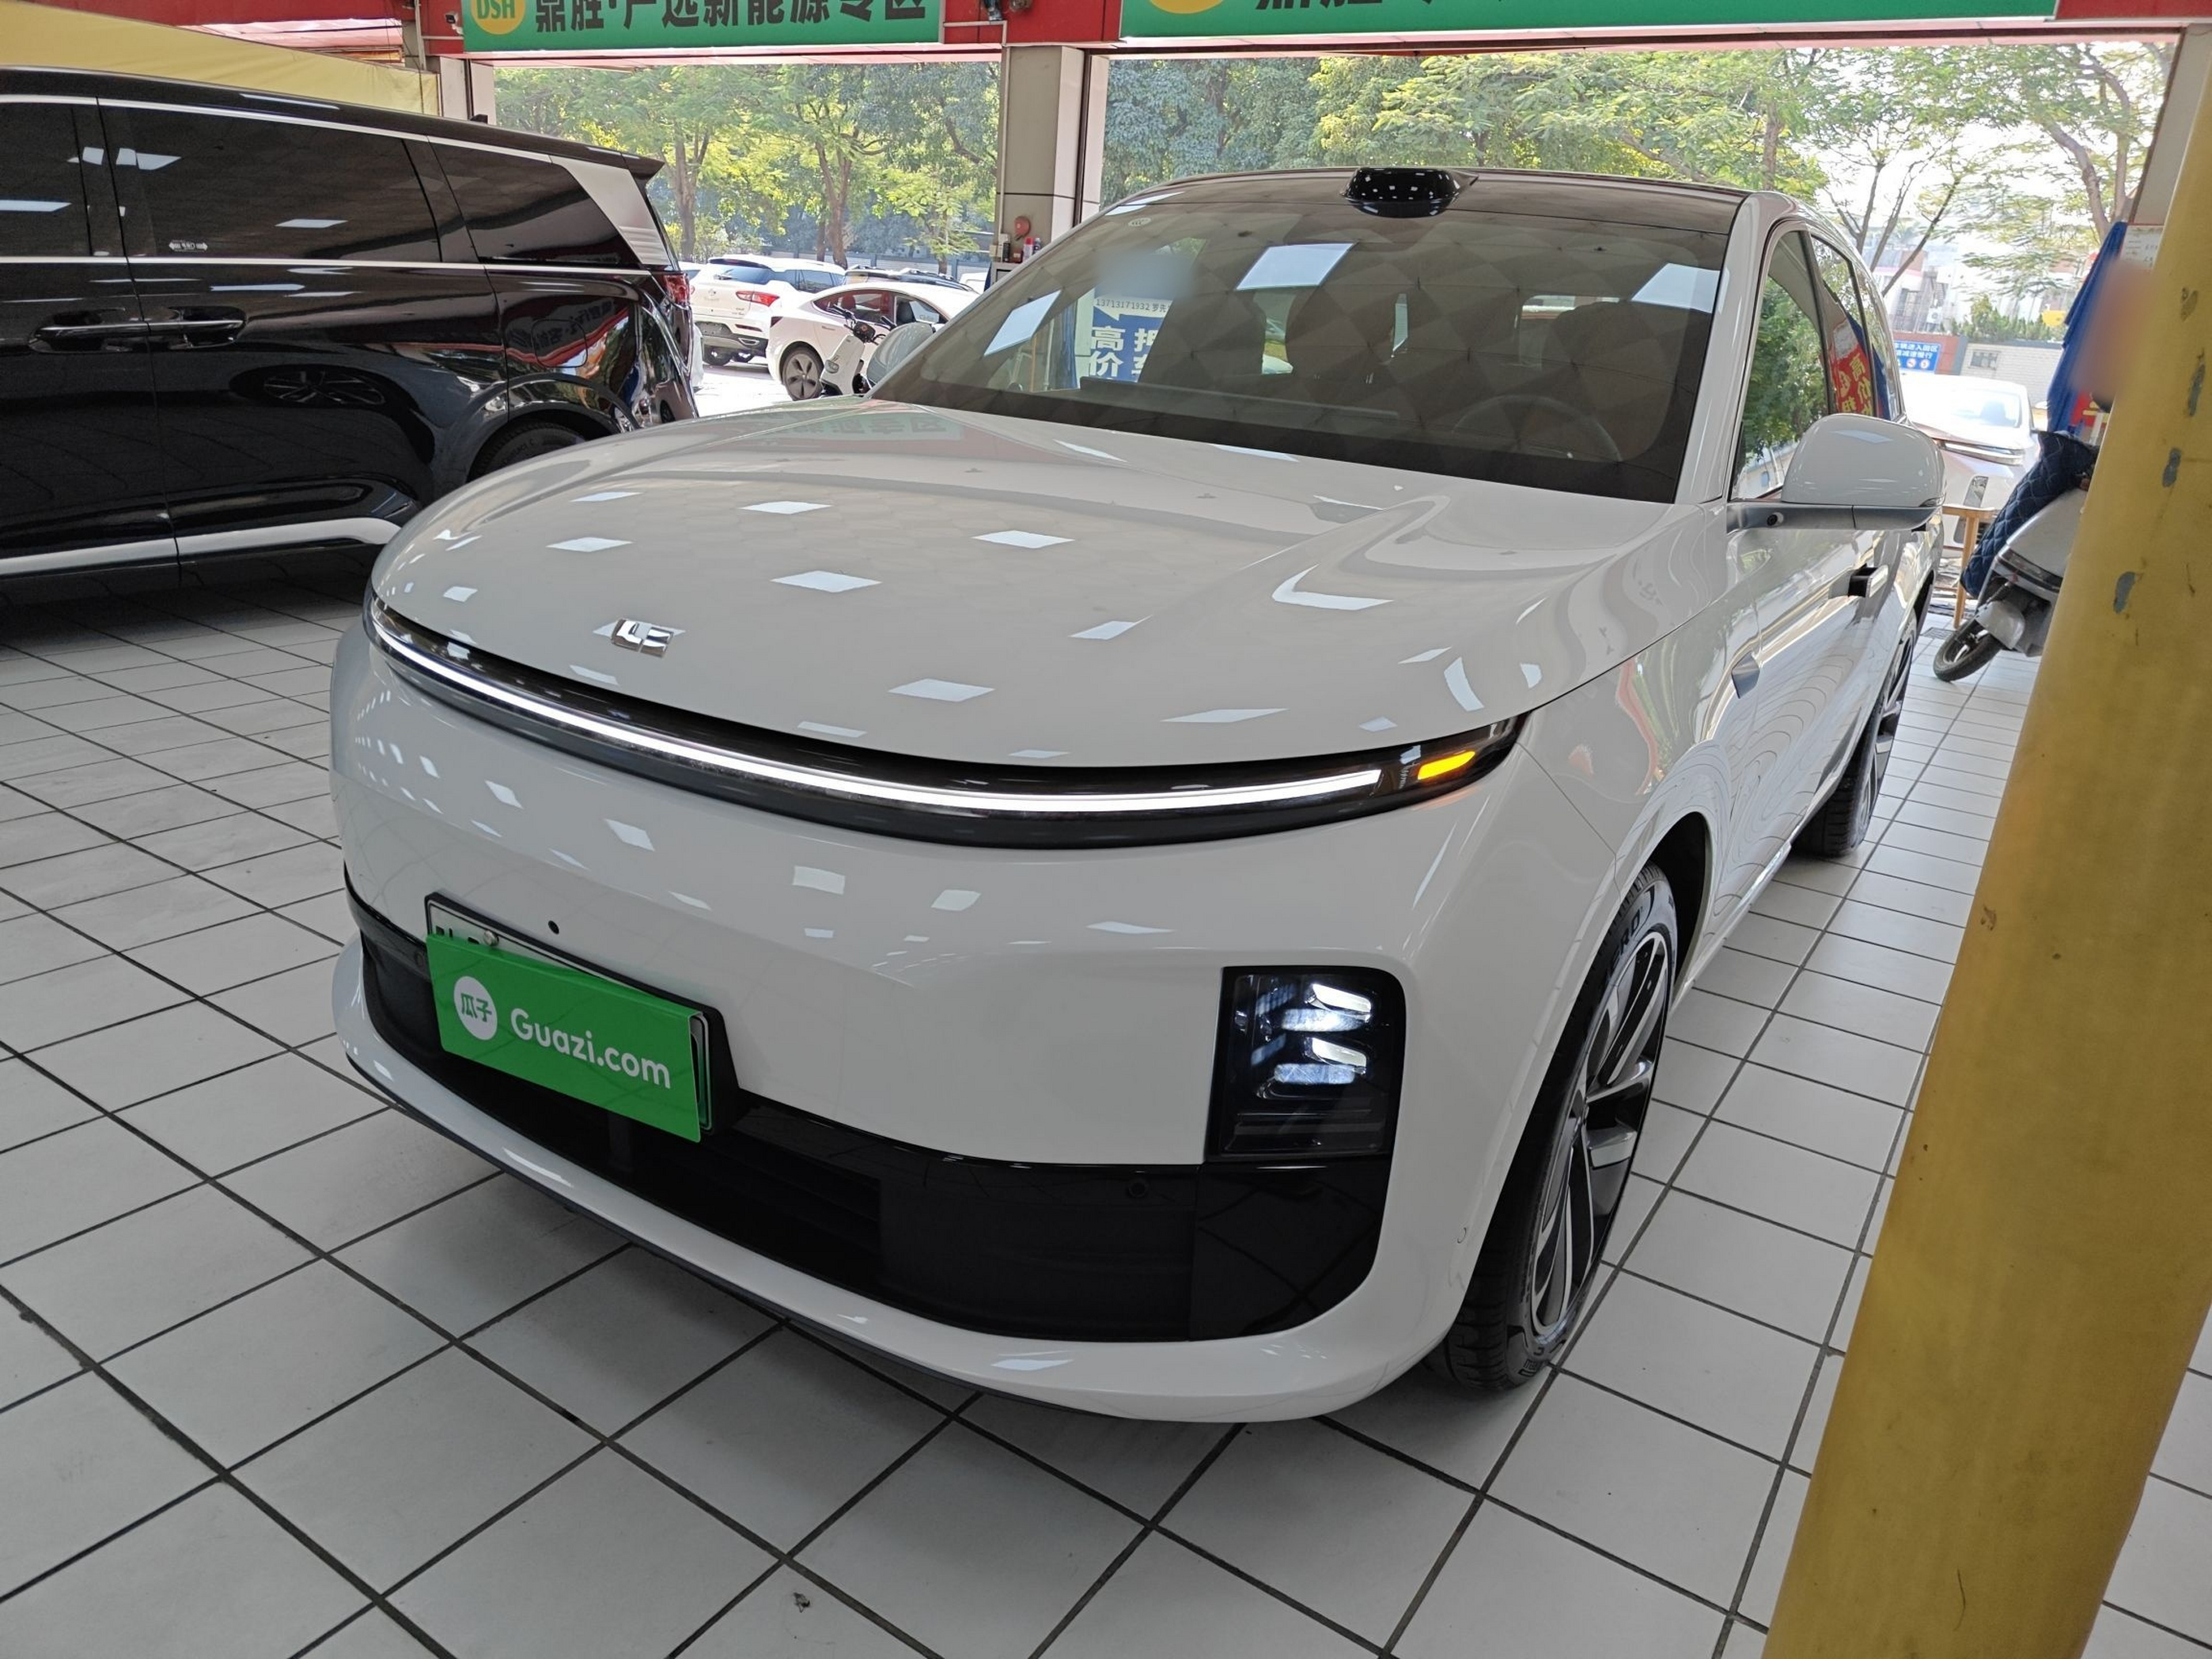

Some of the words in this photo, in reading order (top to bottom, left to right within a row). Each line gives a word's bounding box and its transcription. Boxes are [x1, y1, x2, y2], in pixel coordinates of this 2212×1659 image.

[1152, 303, 1170, 313] 罗先
[460, 993, 493, 1022] 瓜子
[510, 1007, 671, 1089] Guazi.com
